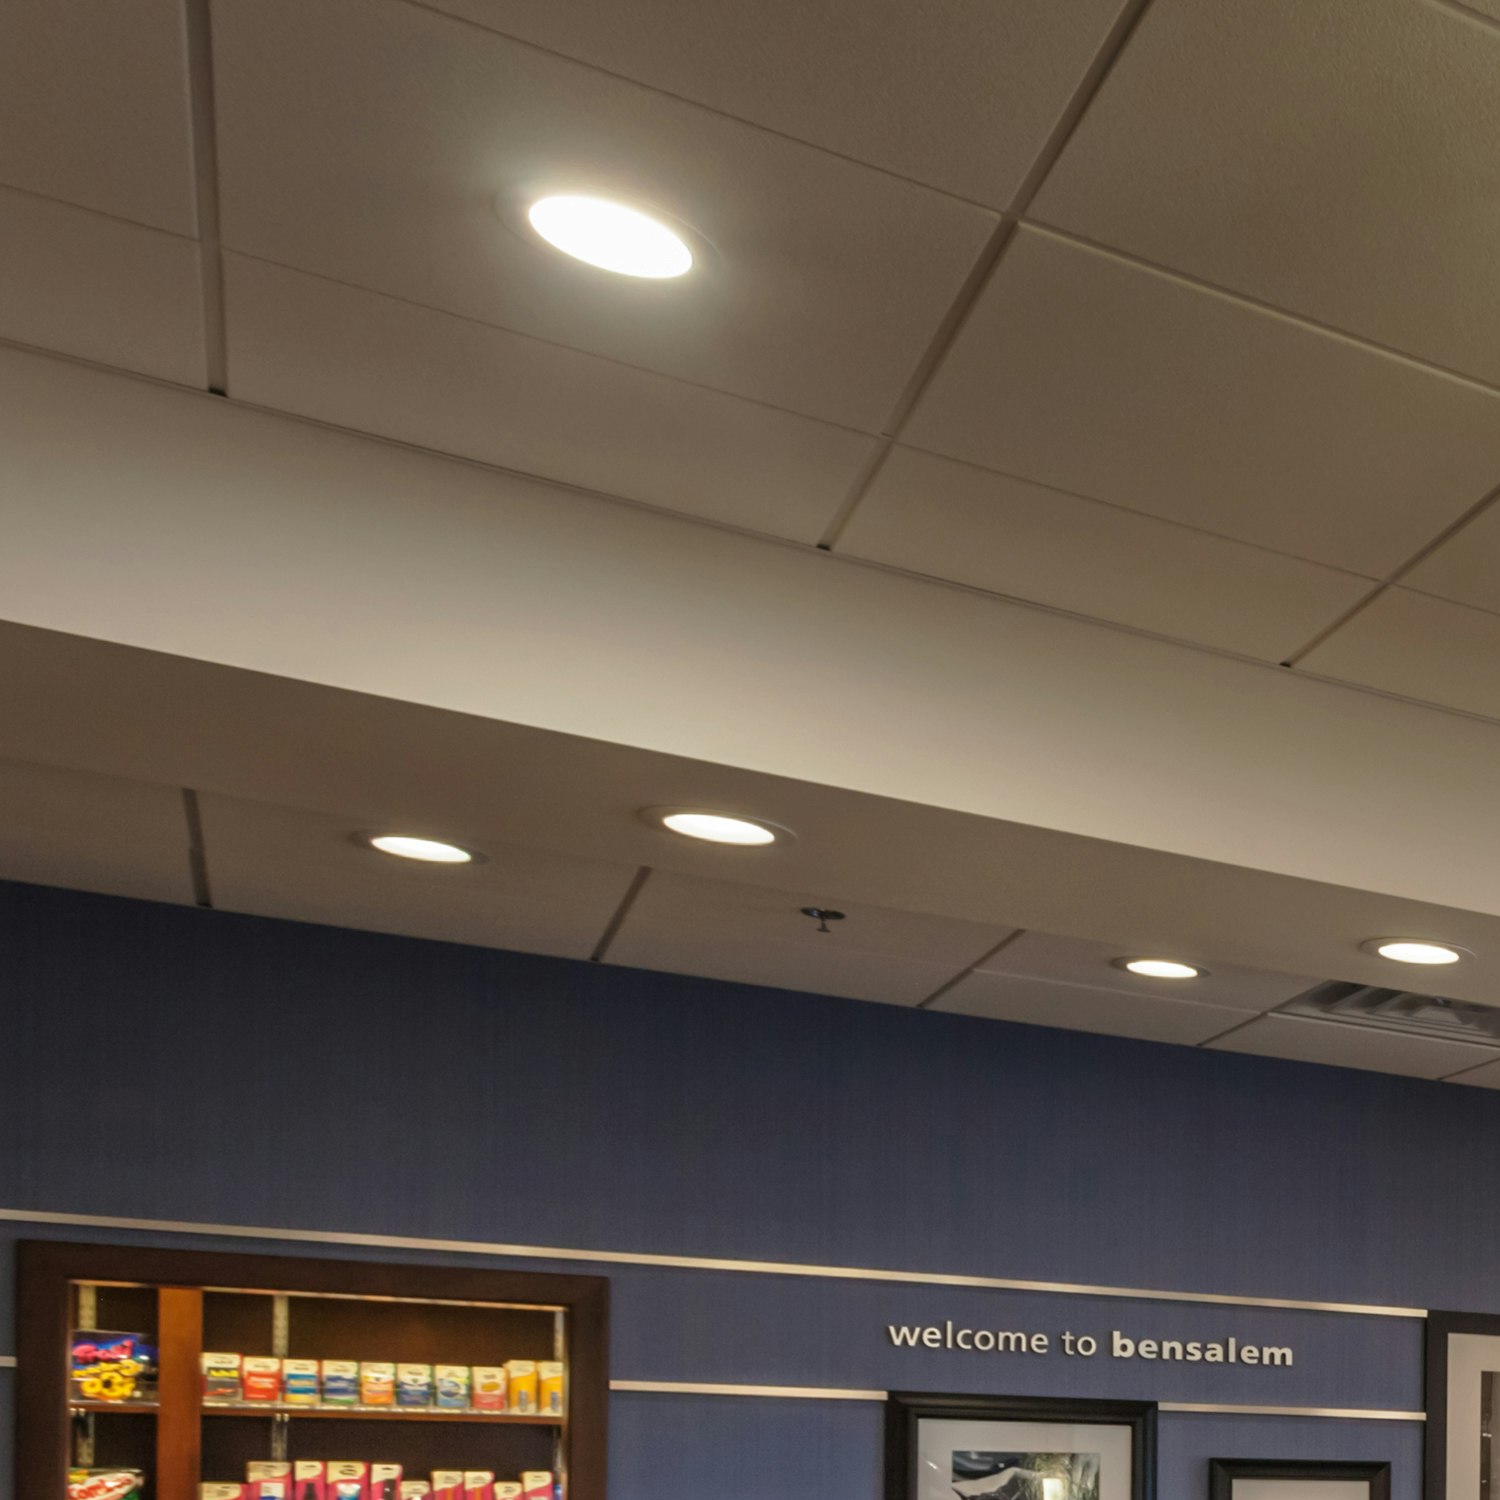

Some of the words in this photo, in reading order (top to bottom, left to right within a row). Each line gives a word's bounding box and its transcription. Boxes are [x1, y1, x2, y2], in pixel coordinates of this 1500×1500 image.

[887, 1320, 1049, 1354] welcome
[1060, 1330, 1098, 1356] to
[1111, 1330, 1295, 1366] bensalem
